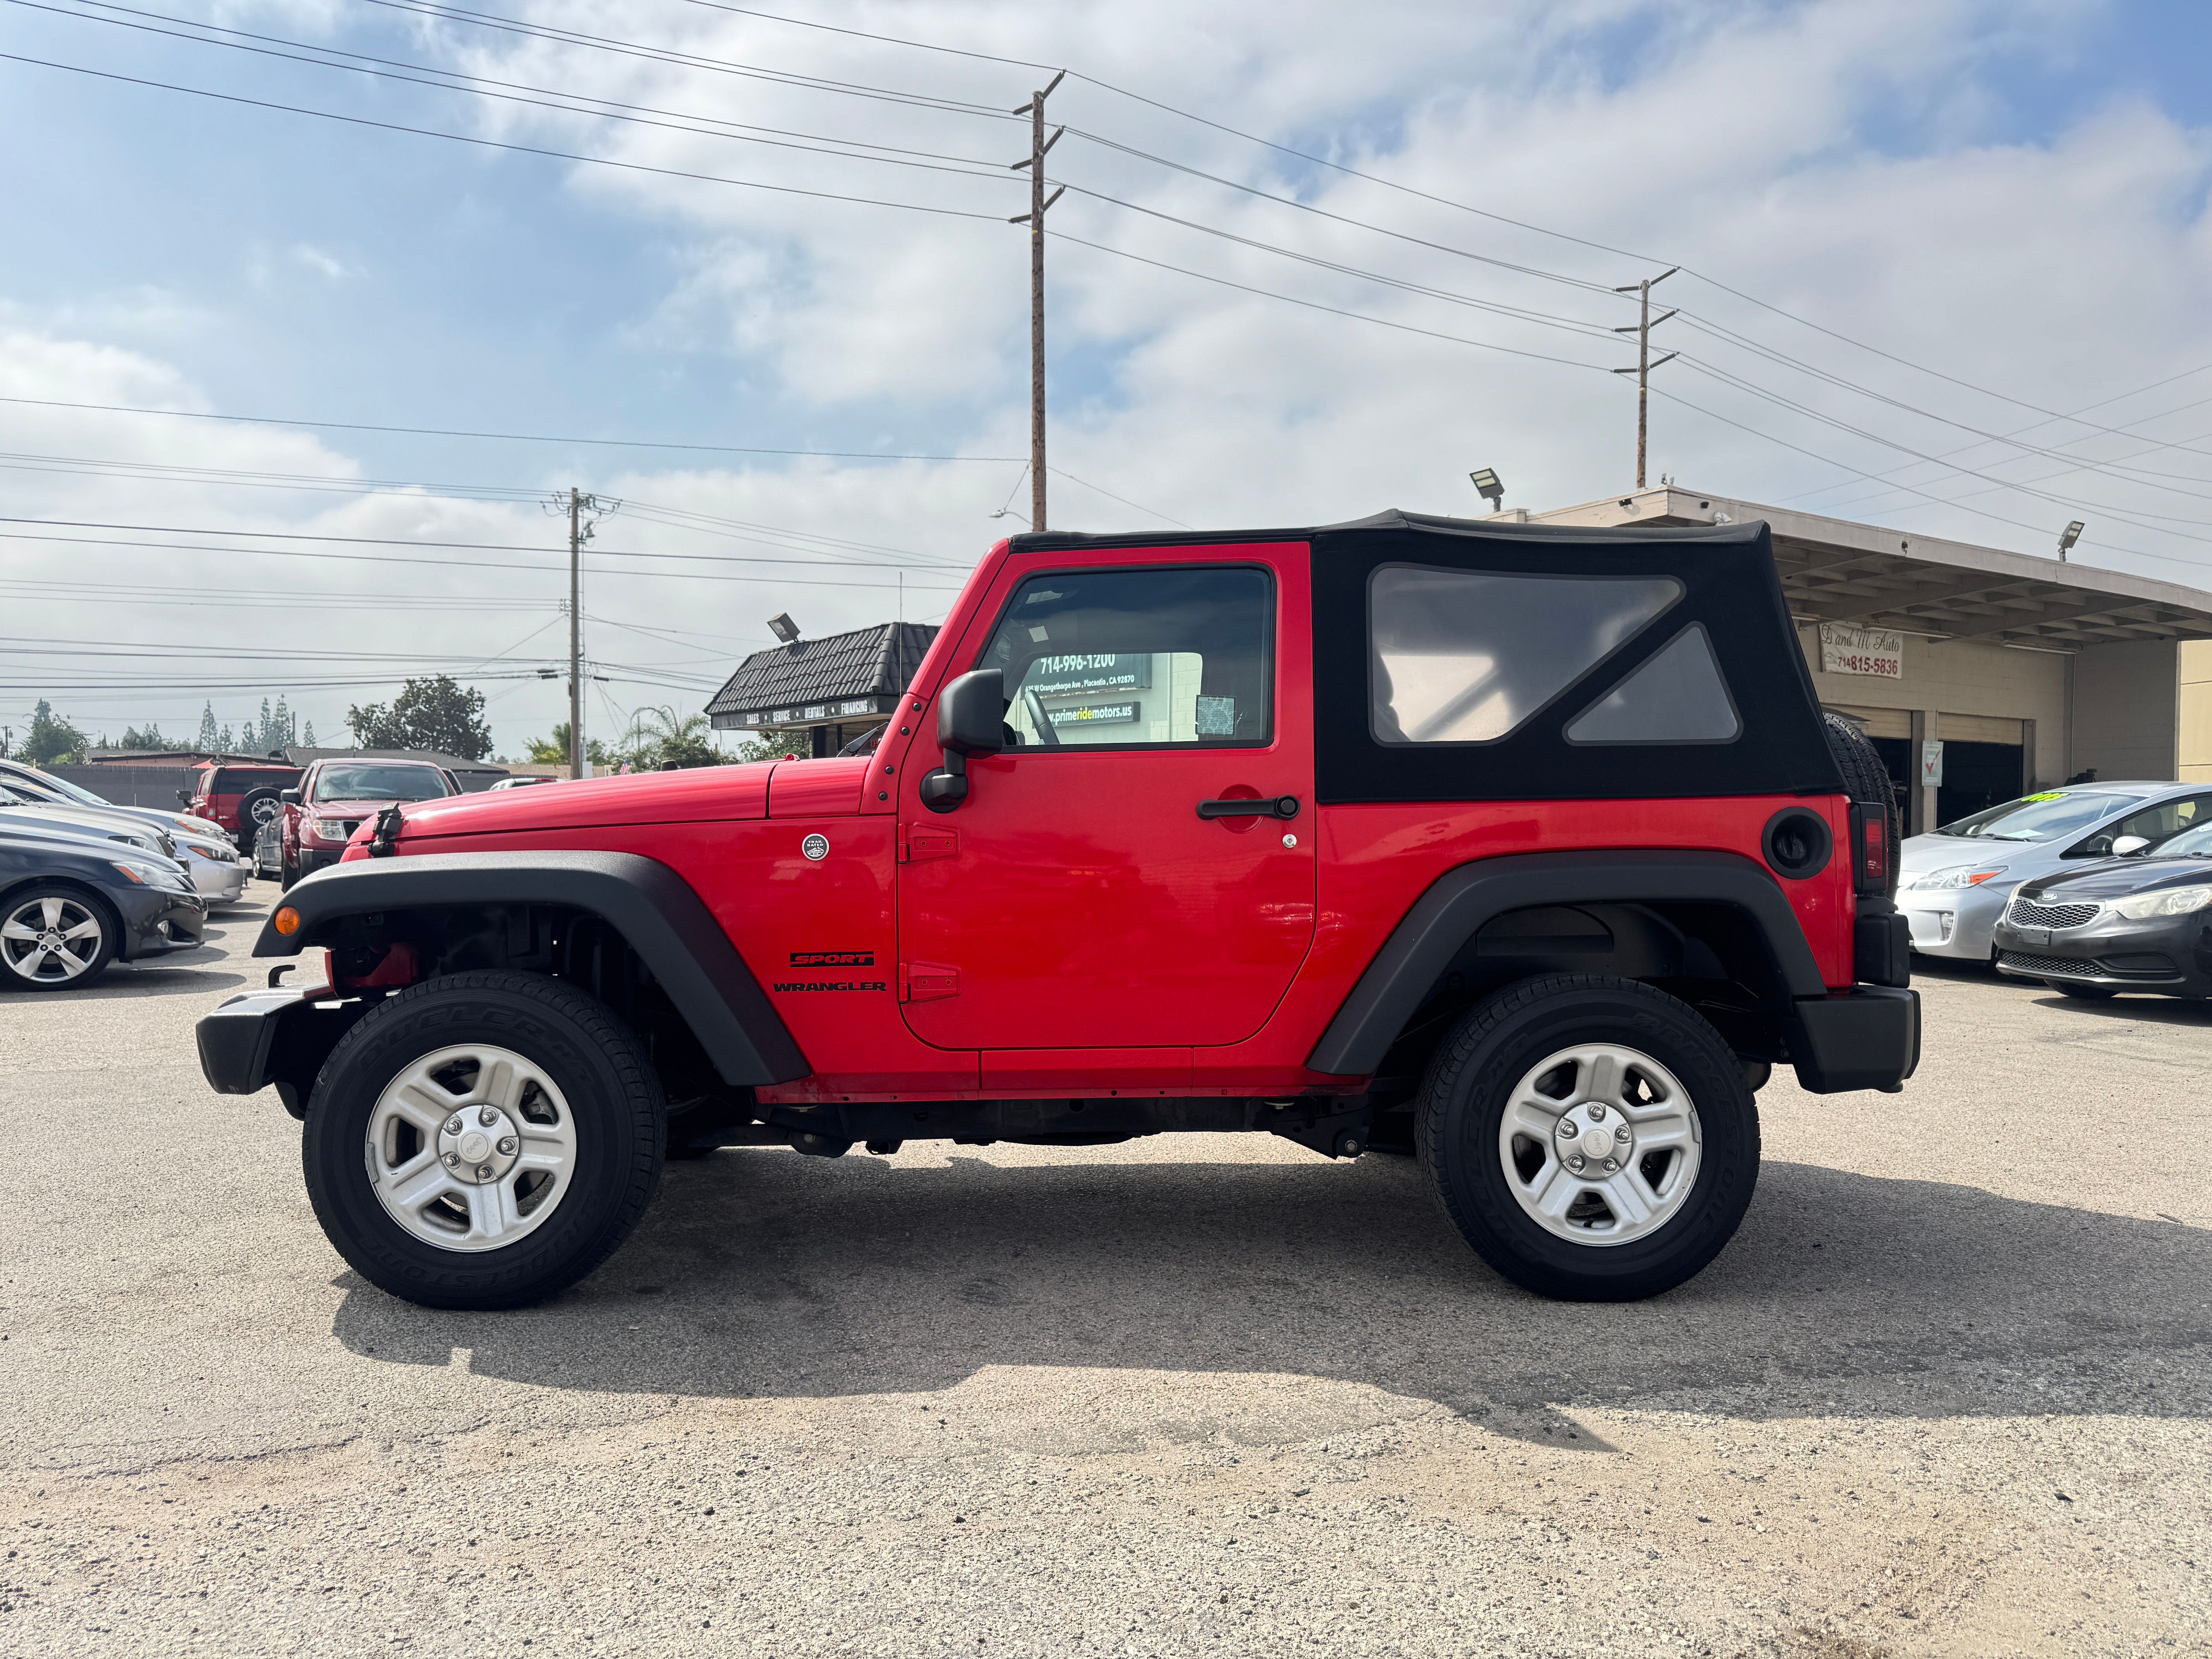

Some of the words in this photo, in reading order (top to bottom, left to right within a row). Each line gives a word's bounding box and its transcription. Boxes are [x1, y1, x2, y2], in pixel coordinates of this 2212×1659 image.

[1835, 629, 1853, 647] and
[1856, 629, 1871, 649] M
[1874, 631, 1899, 652] Auto
[1041, 654, 1115, 674] 714-996-1200
[1039, 682, 1071, 692] Orangethorpe
[1109, 677, 1117, 685] CA
[1117, 675, 1135, 684] 92870
[747, 713, 759, 725] SALES
[773, 709, 790, 722] SERVICE
[805, 705, 825, 719] RENTALS
[841, 700, 868, 715] FINANCING
[790, 954, 874, 964] SPORT
[773, 982, 888, 992] WRANGLER
[356, 1007, 548, 1073] DUELER
[1628, 1010, 1738, 1229] BRIDGESTONE
